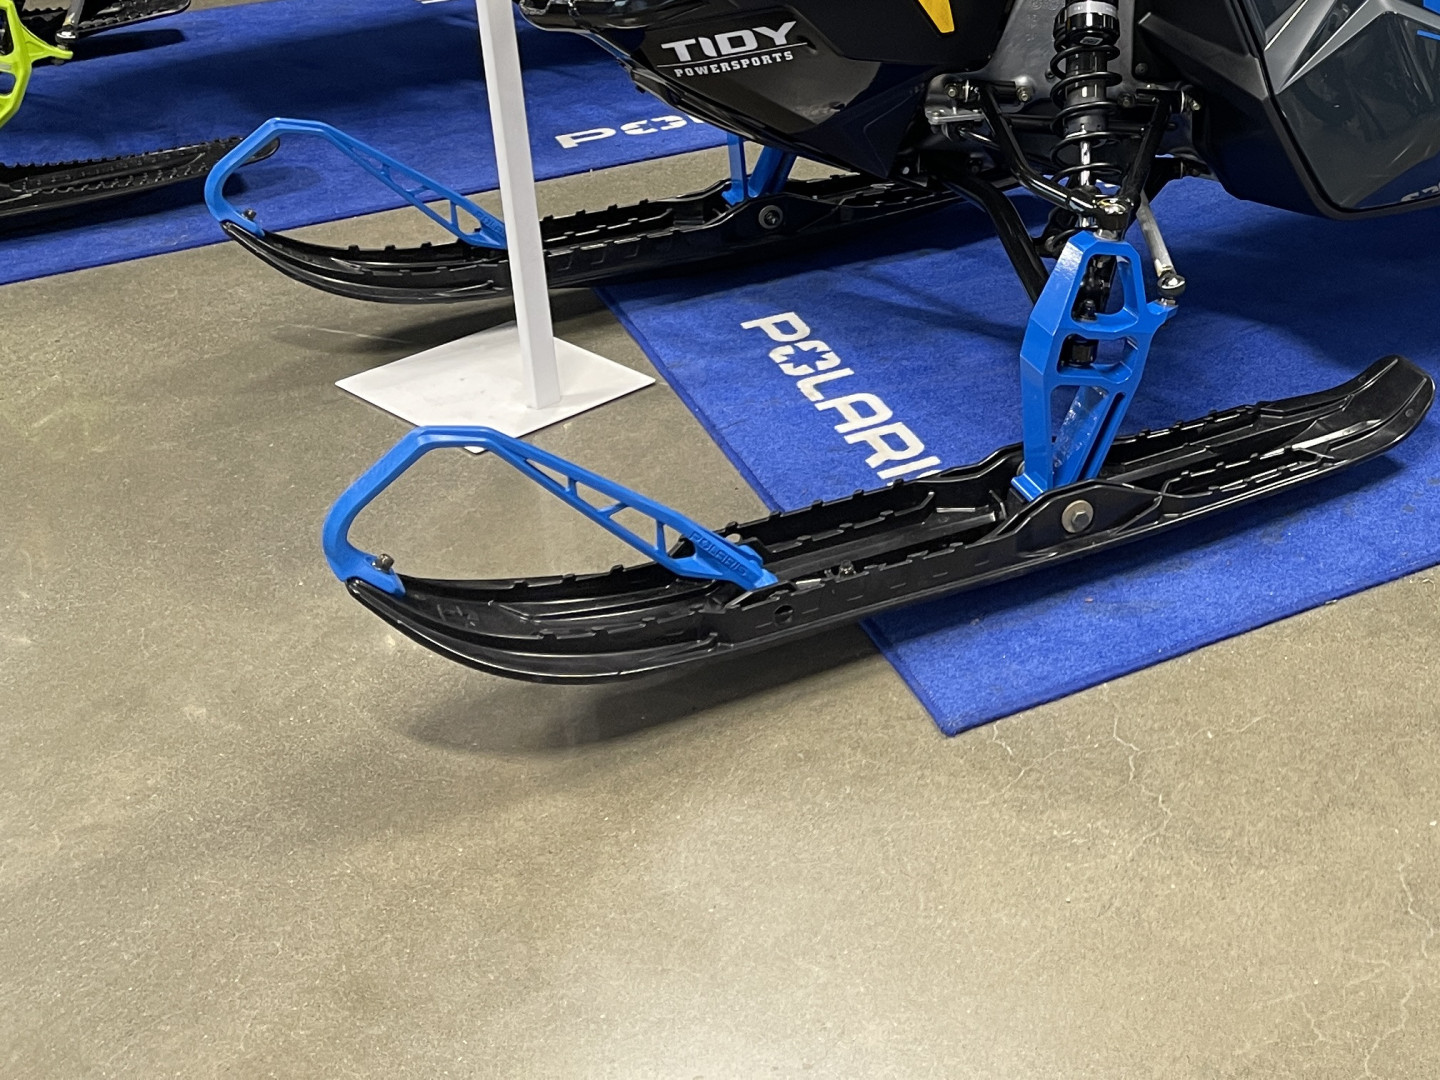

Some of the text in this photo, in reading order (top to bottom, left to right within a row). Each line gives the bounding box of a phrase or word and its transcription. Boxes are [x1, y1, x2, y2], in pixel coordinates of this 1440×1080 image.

[660, 20, 797, 63] TIDY
[673, 50, 795, 78] POWERSPORTS
[739, 311, 942, 487] POLARI
